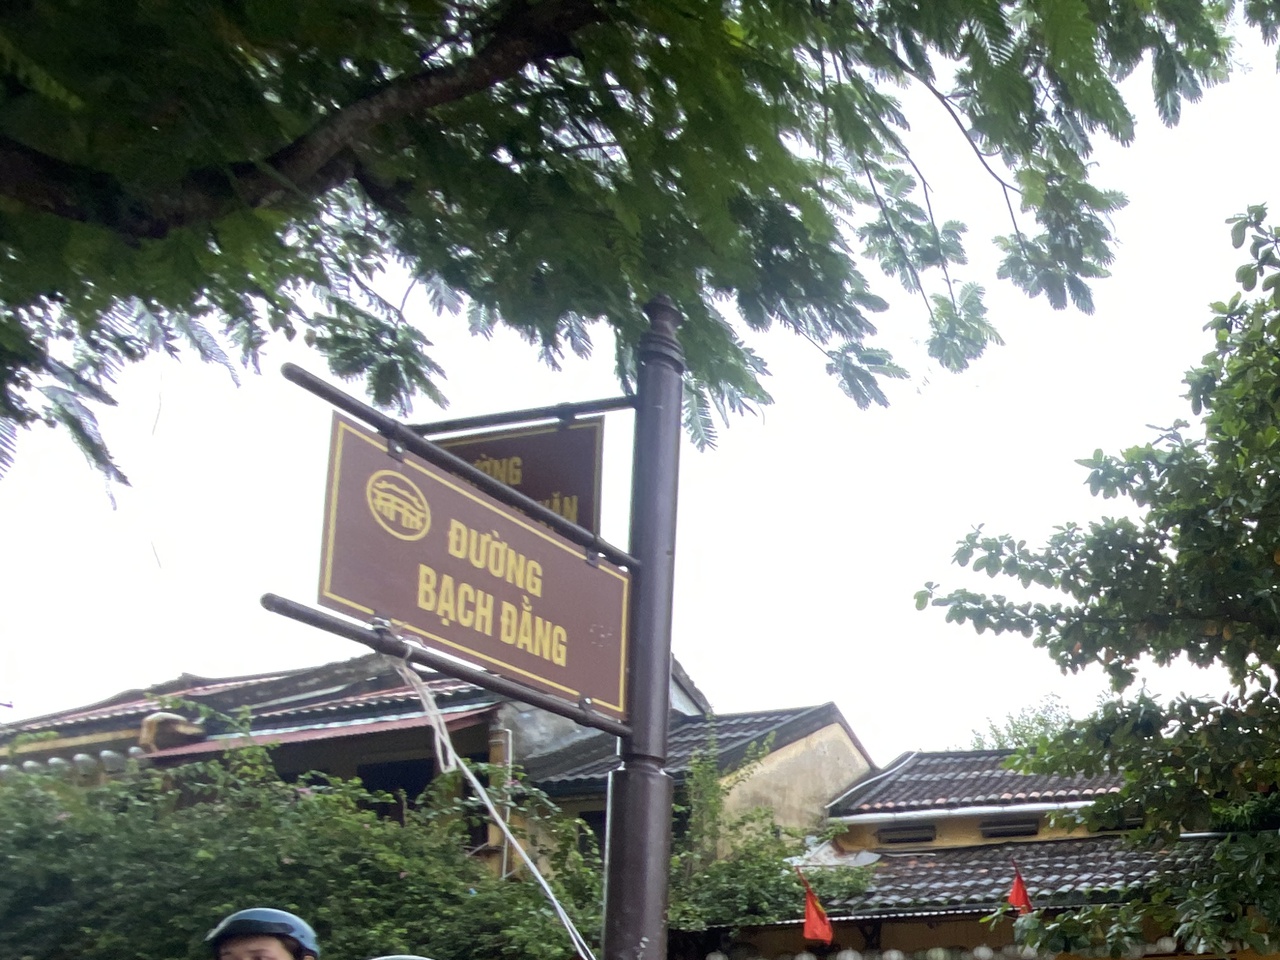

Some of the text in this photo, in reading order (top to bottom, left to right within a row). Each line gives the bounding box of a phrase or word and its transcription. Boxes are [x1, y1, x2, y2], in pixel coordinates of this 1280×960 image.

[448, 518, 543, 597] ĐƯỜNG
[418, 563, 567, 667] BẠCH ĐẰNG
